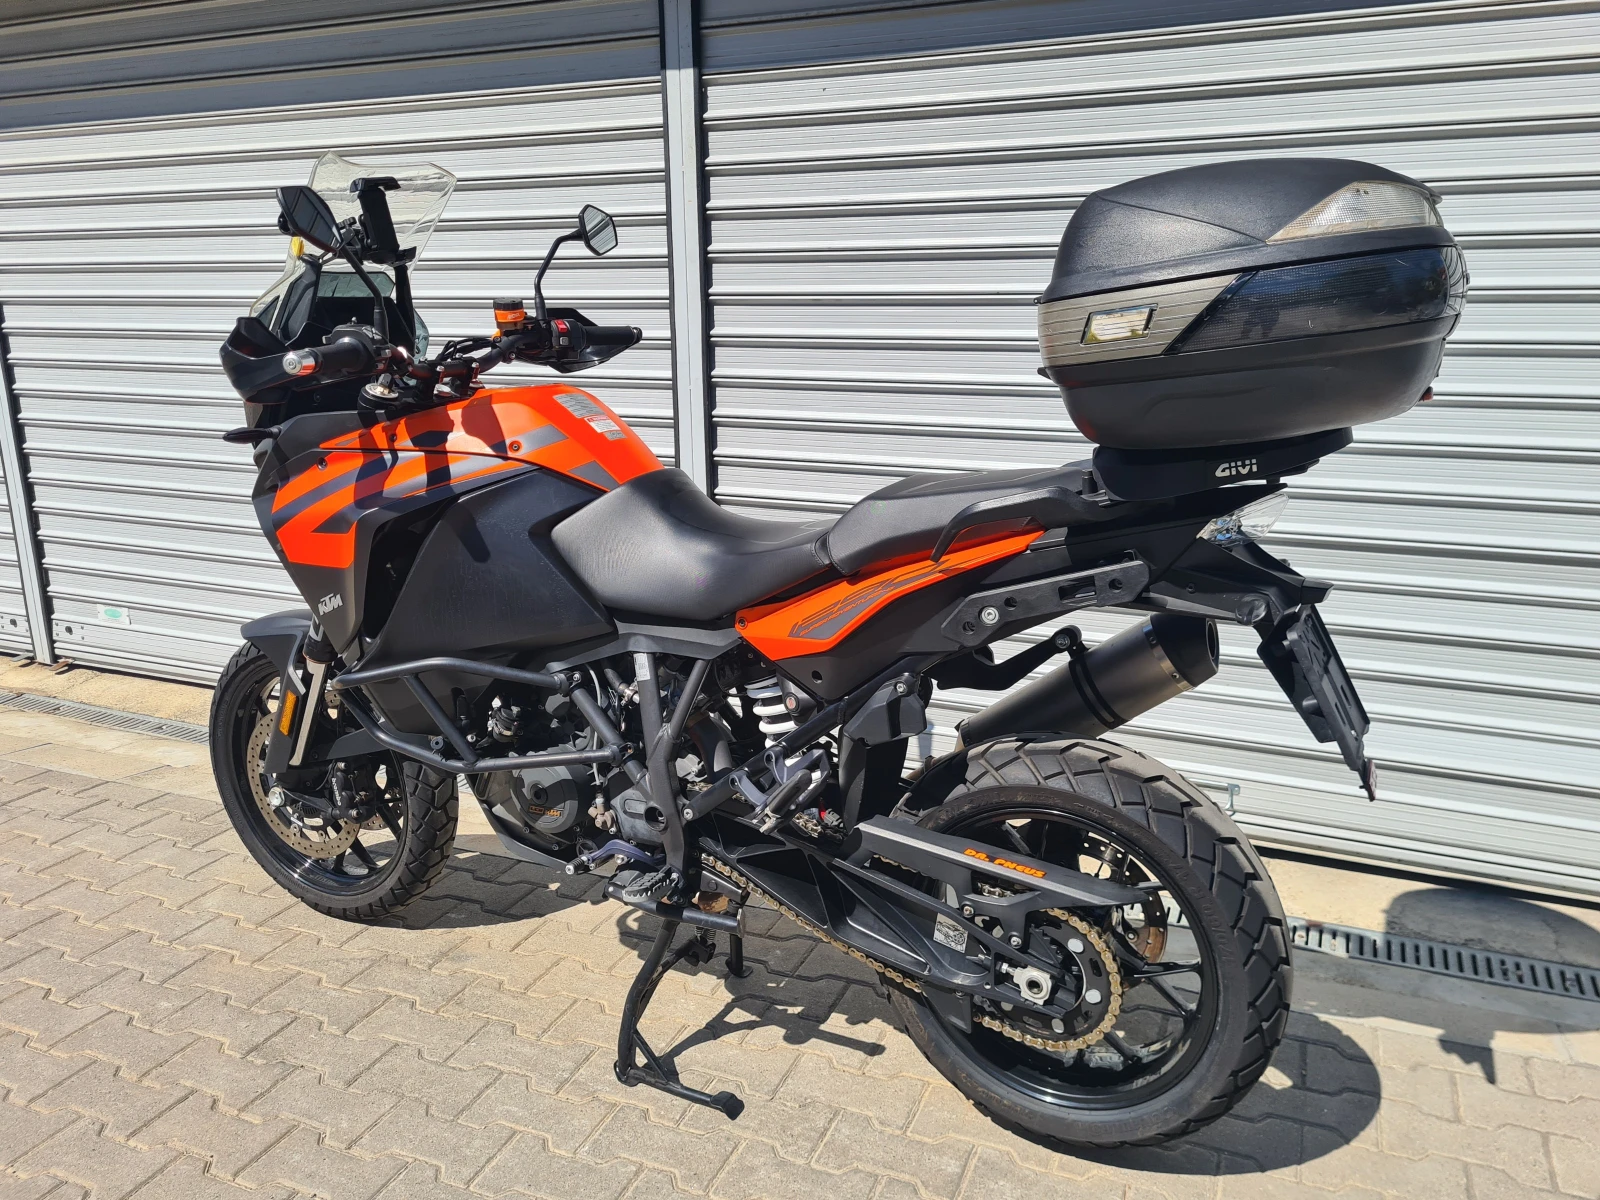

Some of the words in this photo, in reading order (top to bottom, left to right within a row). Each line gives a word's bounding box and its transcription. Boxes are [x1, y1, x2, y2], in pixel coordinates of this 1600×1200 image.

[317, 593, 344, 616] KTM
[331, 777, 342, 806] brembo
[992, 857, 1048, 879] PNEUS
